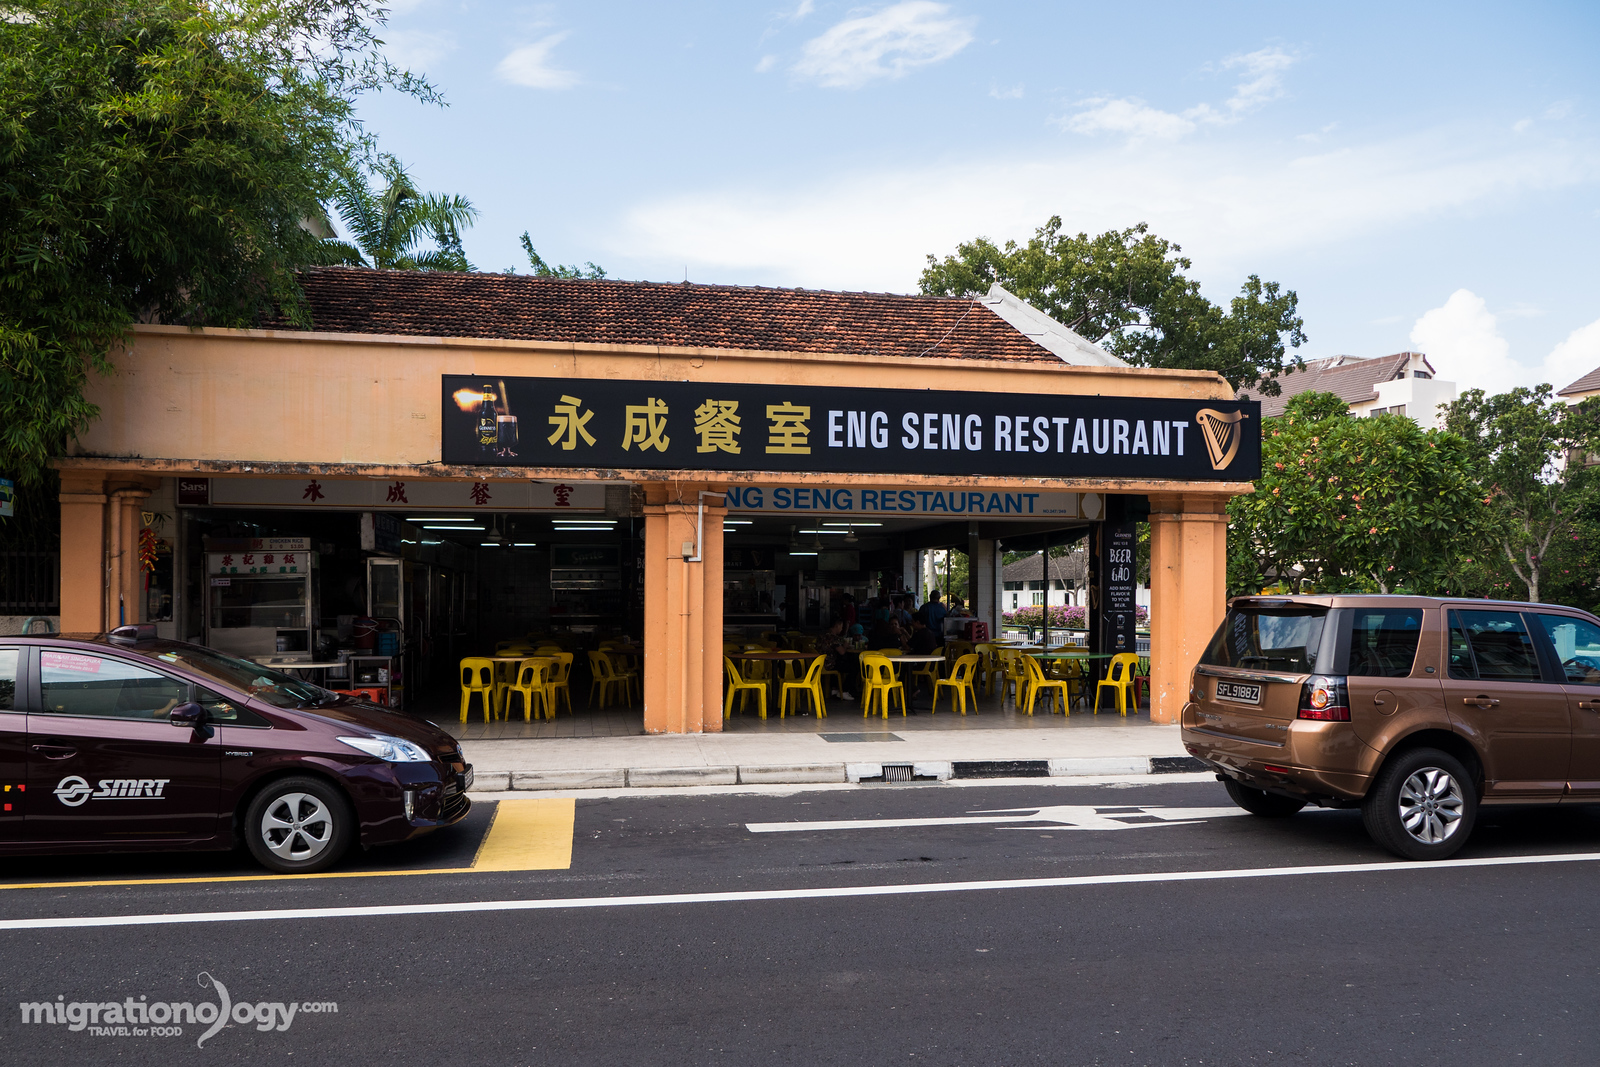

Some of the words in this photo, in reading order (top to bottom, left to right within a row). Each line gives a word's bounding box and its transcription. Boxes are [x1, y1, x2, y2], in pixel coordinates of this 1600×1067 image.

[547, 394, 811, 454] 永成餐室
[828, 410, 889, 449] ENG
[901, 411, 982, 451] SENG
[994, 415, 1189, 456] RESTAURANT
[180, 481, 207, 491] Sarsi
[302, 479, 574, 506] 永成餐室
[724, 487, 763, 508] NG
[773, 487, 853, 510] SENG
[861, 490, 1040, 513] RESTAURANT
[1109, 548, 1131, 564] BEER
[1217, 683, 1259, 700] SFL9188Z
[92, 779, 171, 797] SMRT
